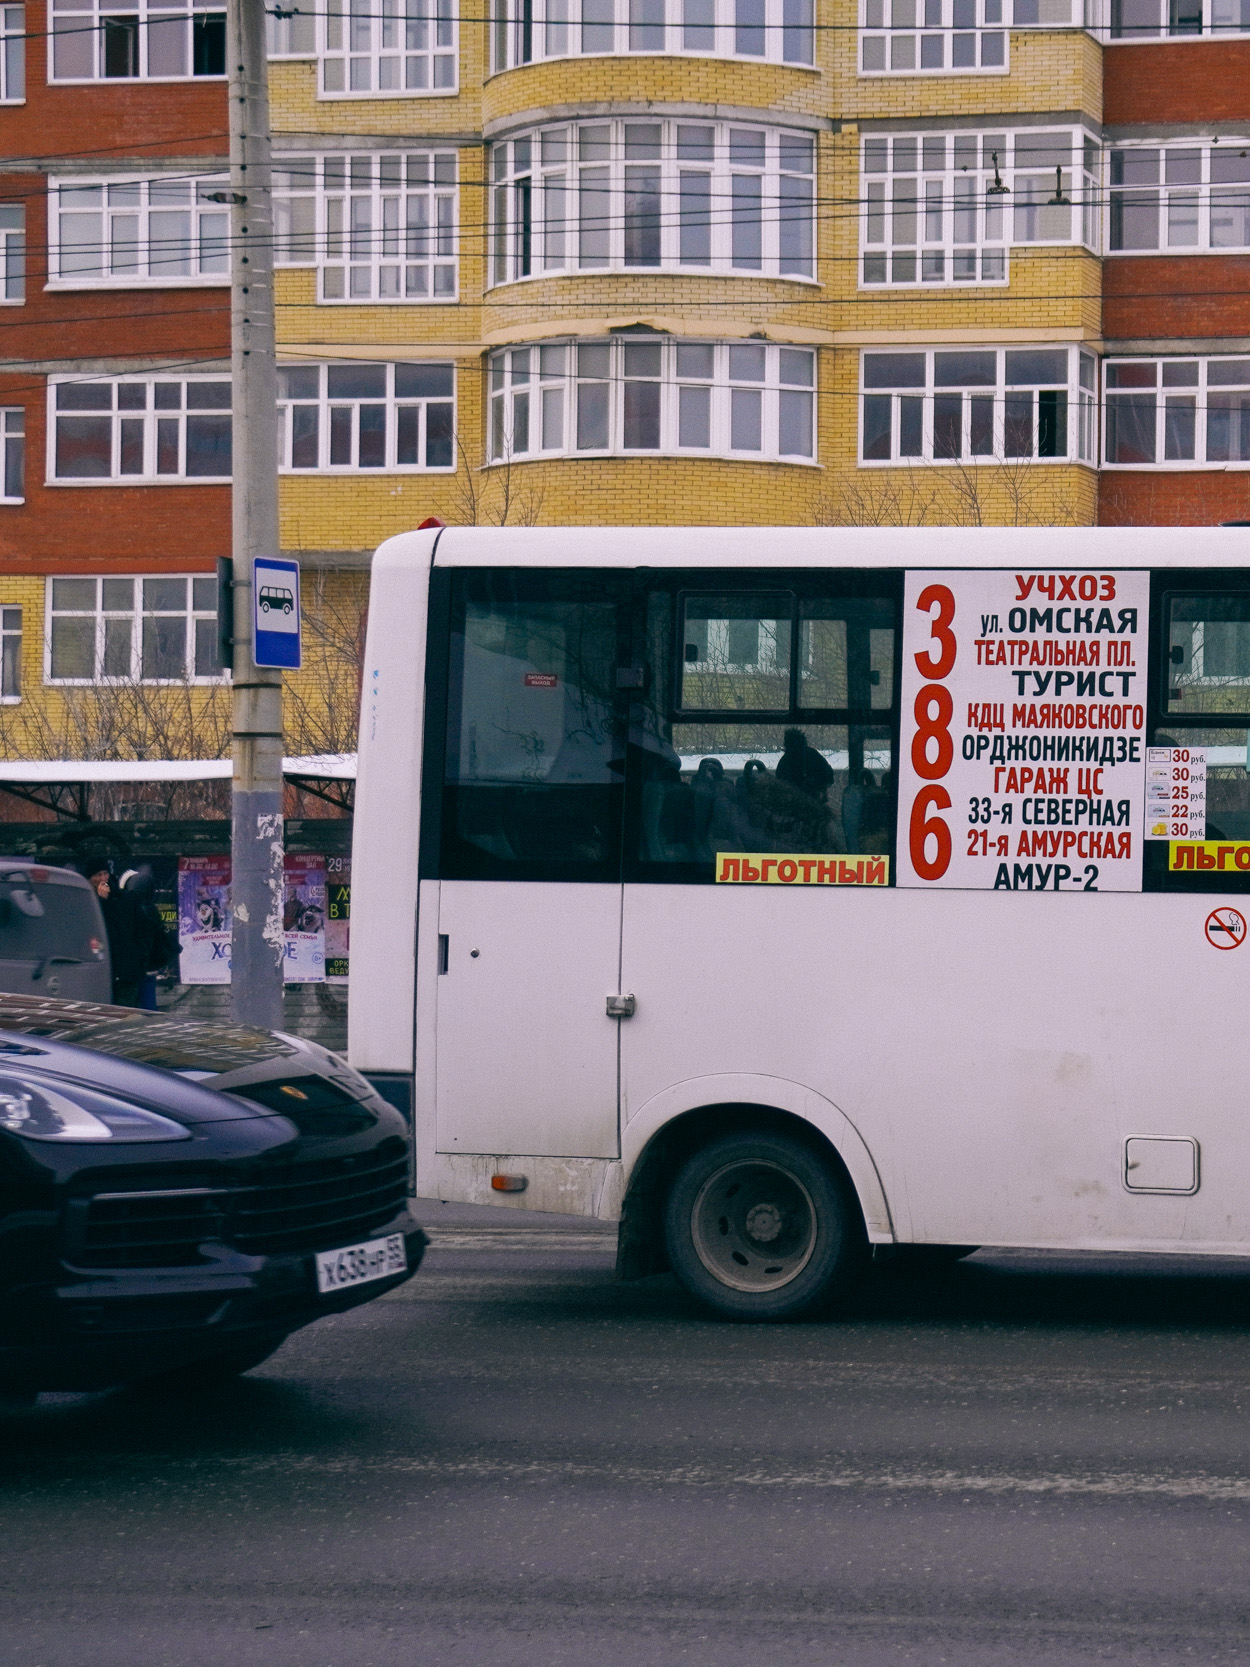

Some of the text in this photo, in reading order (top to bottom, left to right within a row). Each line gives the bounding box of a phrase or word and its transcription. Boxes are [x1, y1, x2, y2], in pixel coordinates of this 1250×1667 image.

[1015, 575, 1116, 601] УЧХОЗ
[980, 607, 1138, 638] ул. ОМСКАЯ
[974, 640, 1136, 667] ТЕАТРАЛЬНАЯ ПЛ.
[1012, 670, 1137, 697] ТУРИСТ
[967, 703, 1144, 732] КДЦ МАЯКОВСКОГО
[962, 734, 1141, 767] ОРДЖОНИКИДЗЕ
[1172, 749, 1206, 765] 30 руб.
[994, 767, 1104, 800] ГАРАЖ ЦС
[1172, 767, 1206, 783] 30 руб.
[1171, 786, 1206, 802] 25 руб.
[968, 796, 1131, 826] 33-я СЕВЕРНАЯ
[1171, 804, 1205, 820] 22 руб.
[1171, 822, 1205, 838] 30 руб.
[967, 829, 1132, 859] 21-я АМУРСКАЯ
[328, 857, 343, 872] 29
[719, 856, 886, 884] ЛЬГОТНЫЙ
[993, 863, 1099, 891] АМУР-2
